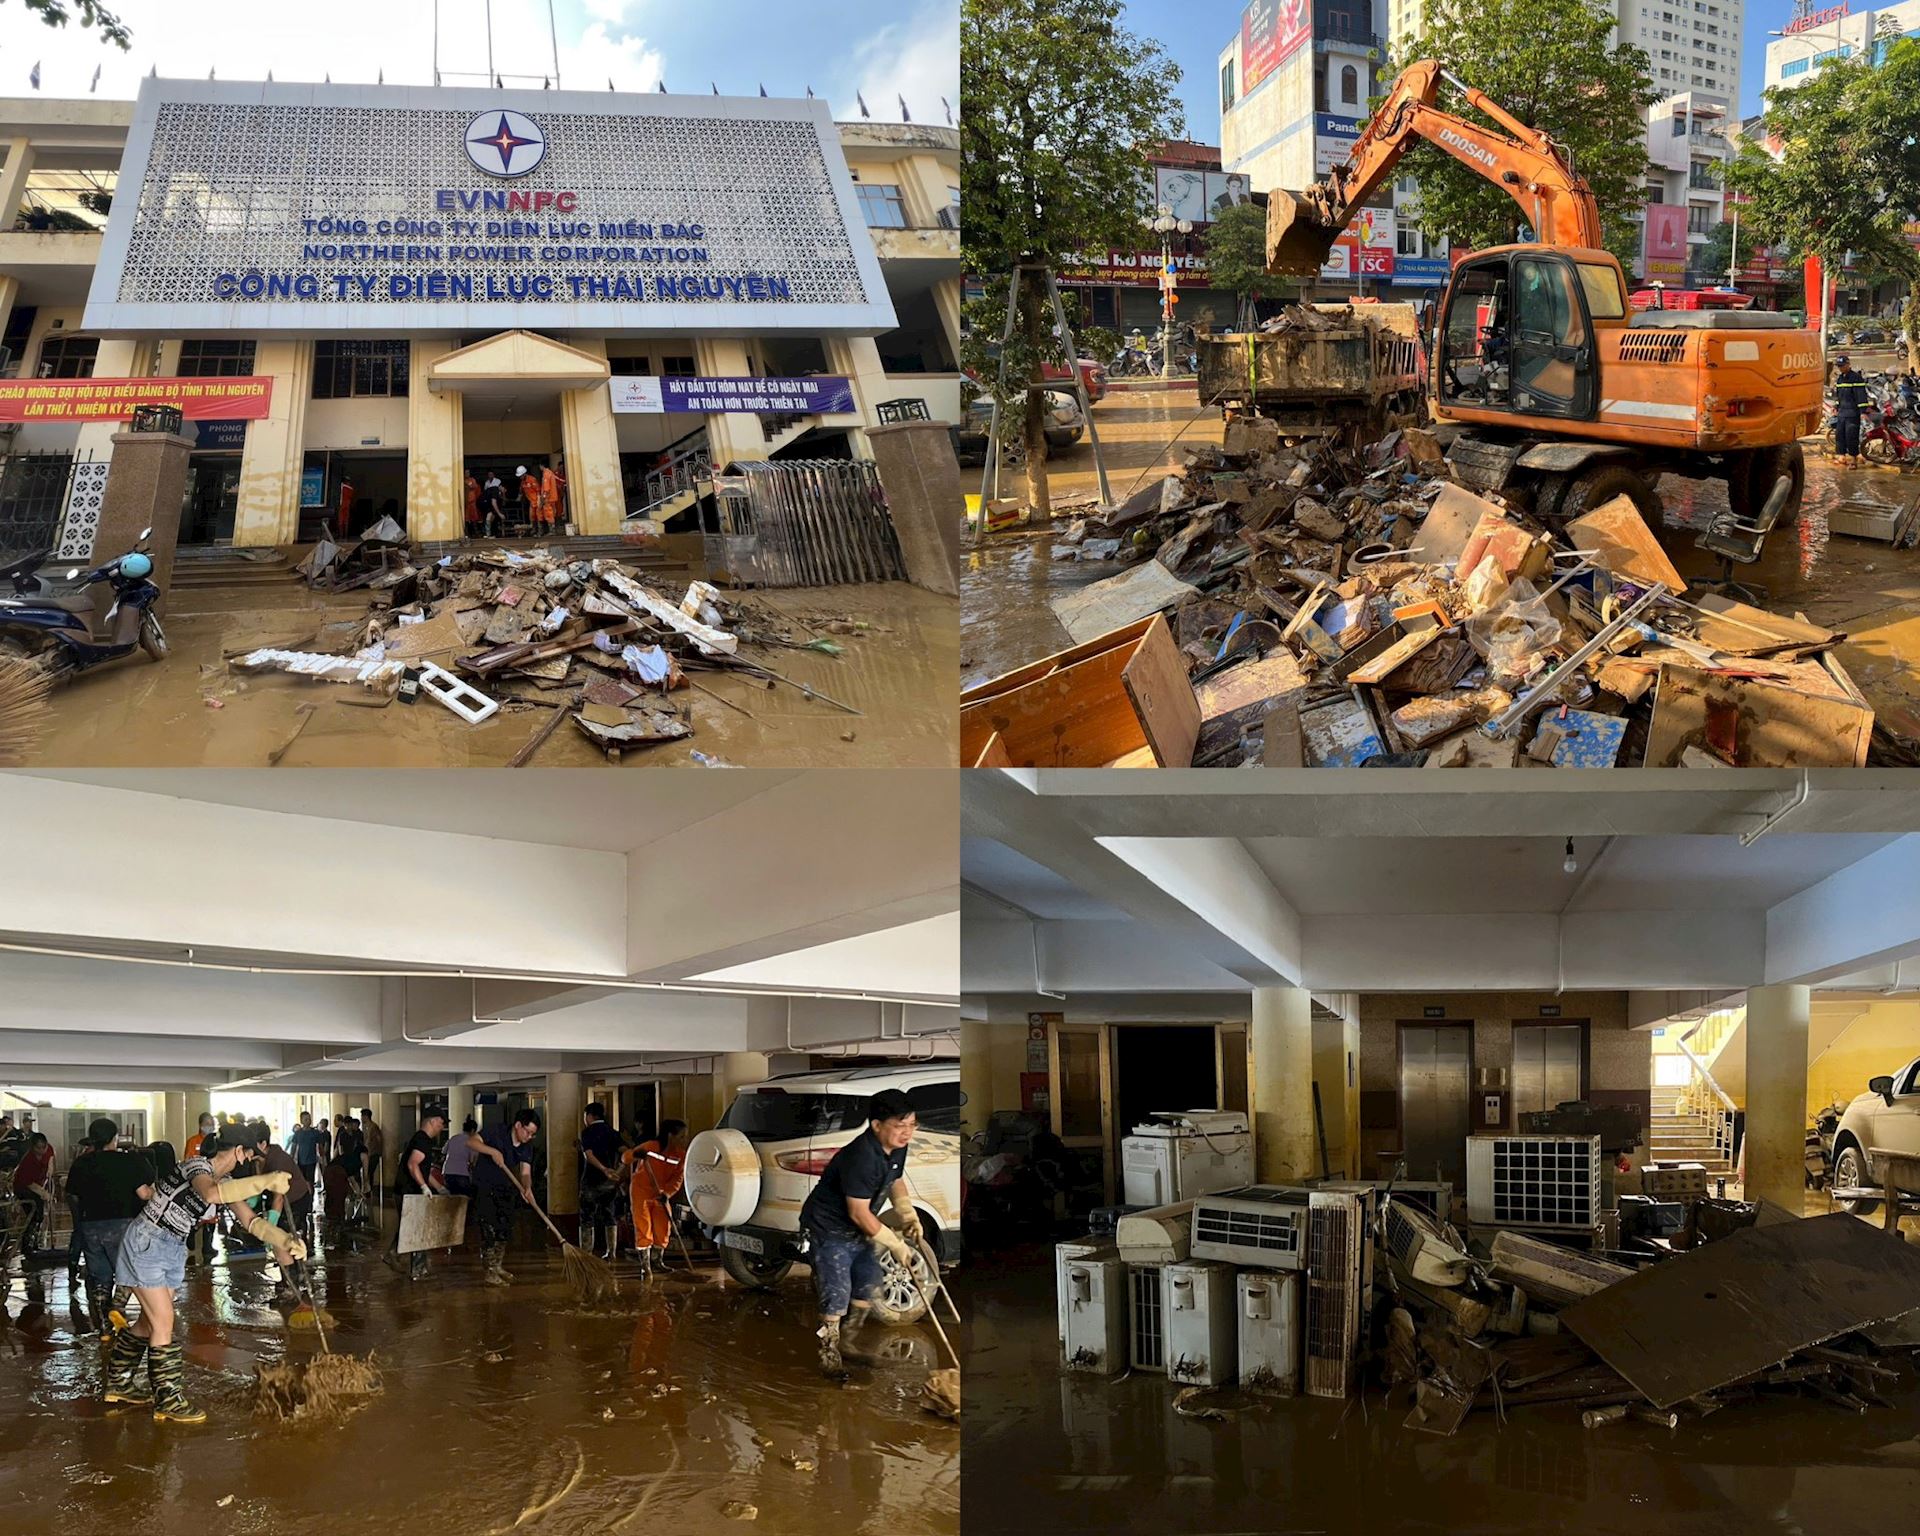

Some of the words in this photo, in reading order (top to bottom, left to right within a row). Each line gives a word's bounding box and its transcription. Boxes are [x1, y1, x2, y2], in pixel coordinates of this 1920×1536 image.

[1439, 128, 1498, 167] DOOSAN
[436, 190, 578, 213] EVNNPC
[375, 216, 442, 236] CÔNG
[450, 221, 478, 237] TY
[303, 244, 441, 261] NORTHERN
[450, 245, 533, 262] POWER
[541, 246, 708, 263] CORPORATION
[213, 267, 318, 299] CÔNG
[333, 274, 378, 299] TY
[565, 270, 644, 299] THÁI
[655, 271, 791, 300] NGUYÊN
[1113, 269, 1139, 280] phong
[27, 385, 56, 398] MỪNG
[58, 387, 75, 401] ĐẠI
[78, 384, 93, 400] HỘI
[95, 386, 111, 400] ĐẠI
[114, 382, 137, 397] BIỂU
[137, 382, 164, 397] ĐẢNG
[166, 383, 179, 399] BỘ
[182, 382, 202, 396] TỈNH
[205, 383, 225, 396] THÁI
[227, 382, 264, 396] NGUYÊN
[669, 379, 686, 393] HÃY
[688, 378, 704, 393] ĐẦU
[706, 380, 717, 393] TƯ
[718, 379, 737, 393] HÔM
[737, 381, 754, 393] NAY
[756, 378, 767, 393] ĐỂ
[768, 379, 780, 393] CÓ
[780, 379, 802, 393] NGÀY
[802, 381, 820, 393] MAI
[24, 401, 45, 415] LẦN
[46, 402, 66, 415] THỨ
[75, 401, 107, 417] NHIỆM
[688, 397, 700, 410] AN
[701, 395, 724, 410] TOÀN
[724, 397, 742, 410] HƠN
[742, 395, 770, 410] TRƯỚC
[770, 395, 793, 410] THIÊN
[793, 397, 808, 410] TAI
